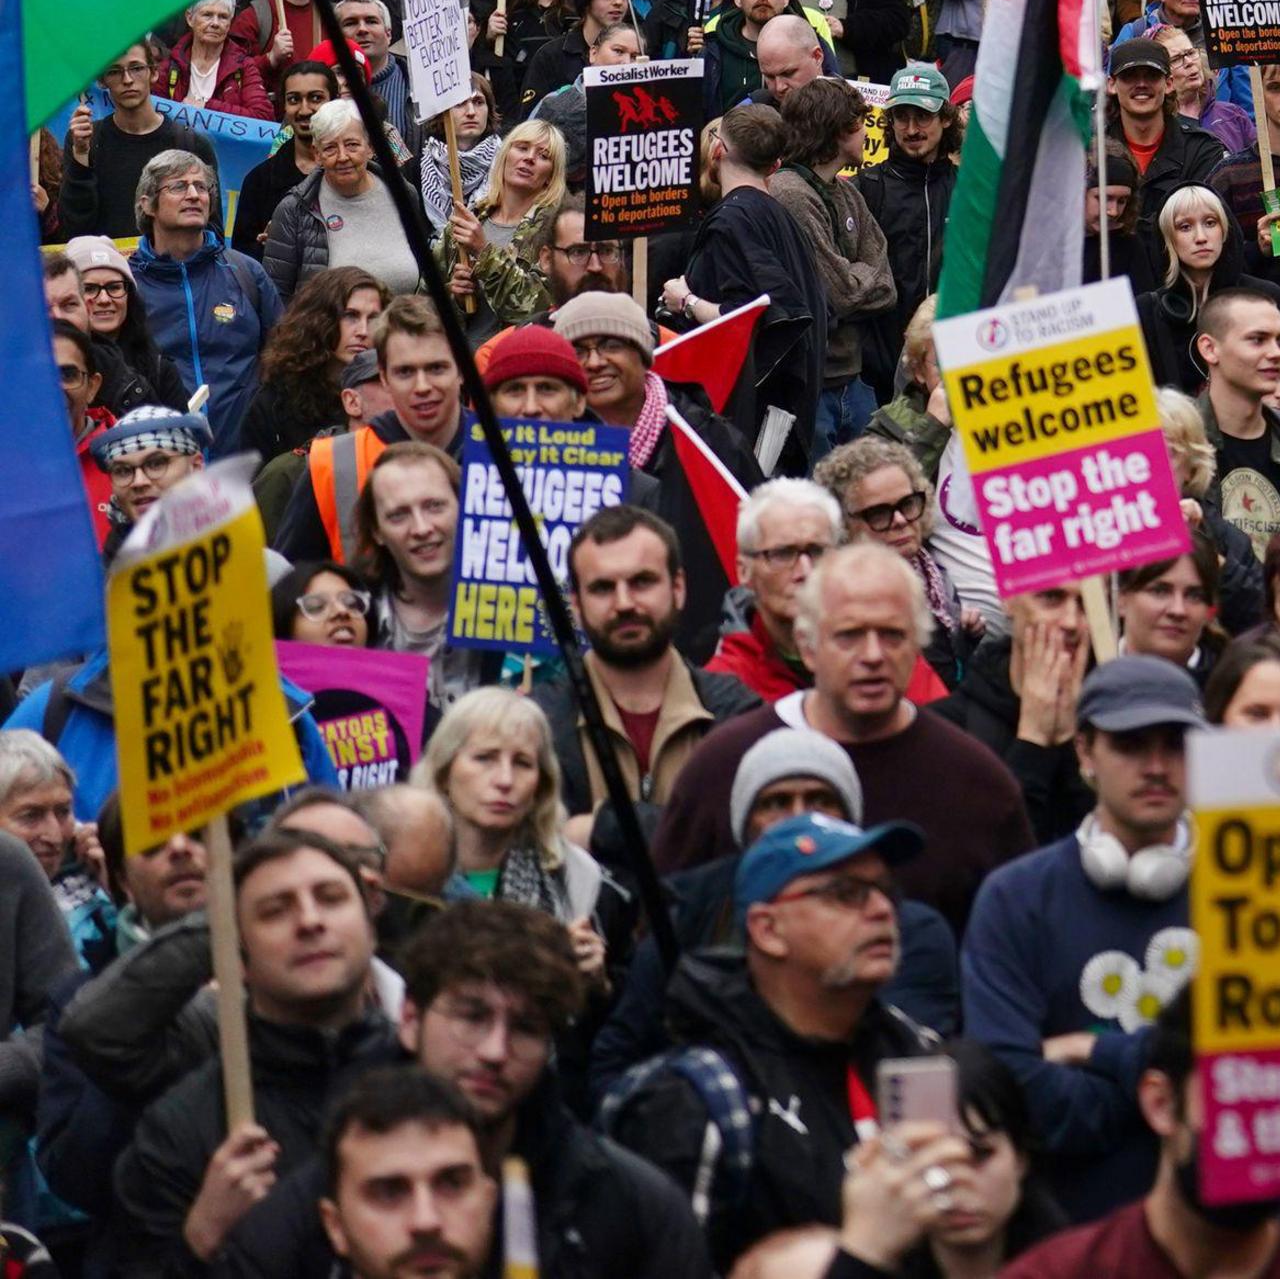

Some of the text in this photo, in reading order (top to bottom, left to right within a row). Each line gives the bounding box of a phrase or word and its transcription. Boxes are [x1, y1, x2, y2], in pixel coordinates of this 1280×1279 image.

[407, 7, 461, 50] BETTER THAN
[419, 28, 461, 69] EVERYONE
[433, 60, 460, 97] ELSE!
[600, 64, 689, 83] Socialist Worker
[593, 128, 694, 166] REFUGEES
[592, 157, 692, 194] WELCOME
[601, 187, 688, 210] Open the borders
[601, 204, 682, 224] No deportations
[959, 344, 1137, 410] Refugees
[516, 426, 596, 446] It Loud
[970, 392, 1139, 454] welcome
[540, 447, 625, 466] It Clear
[982, 451, 1151, 518] Stop the
[993, 523, 1055, 565] far
[1062, 491, 1161, 549] right
[130, 532, 233, 620] STOP
[134, 596, 213, 670] THE
[452, 582, 538, 644] HERE
[140, 655, 215, 729] FAR
[145, 682, 255, 782] RIGHT
